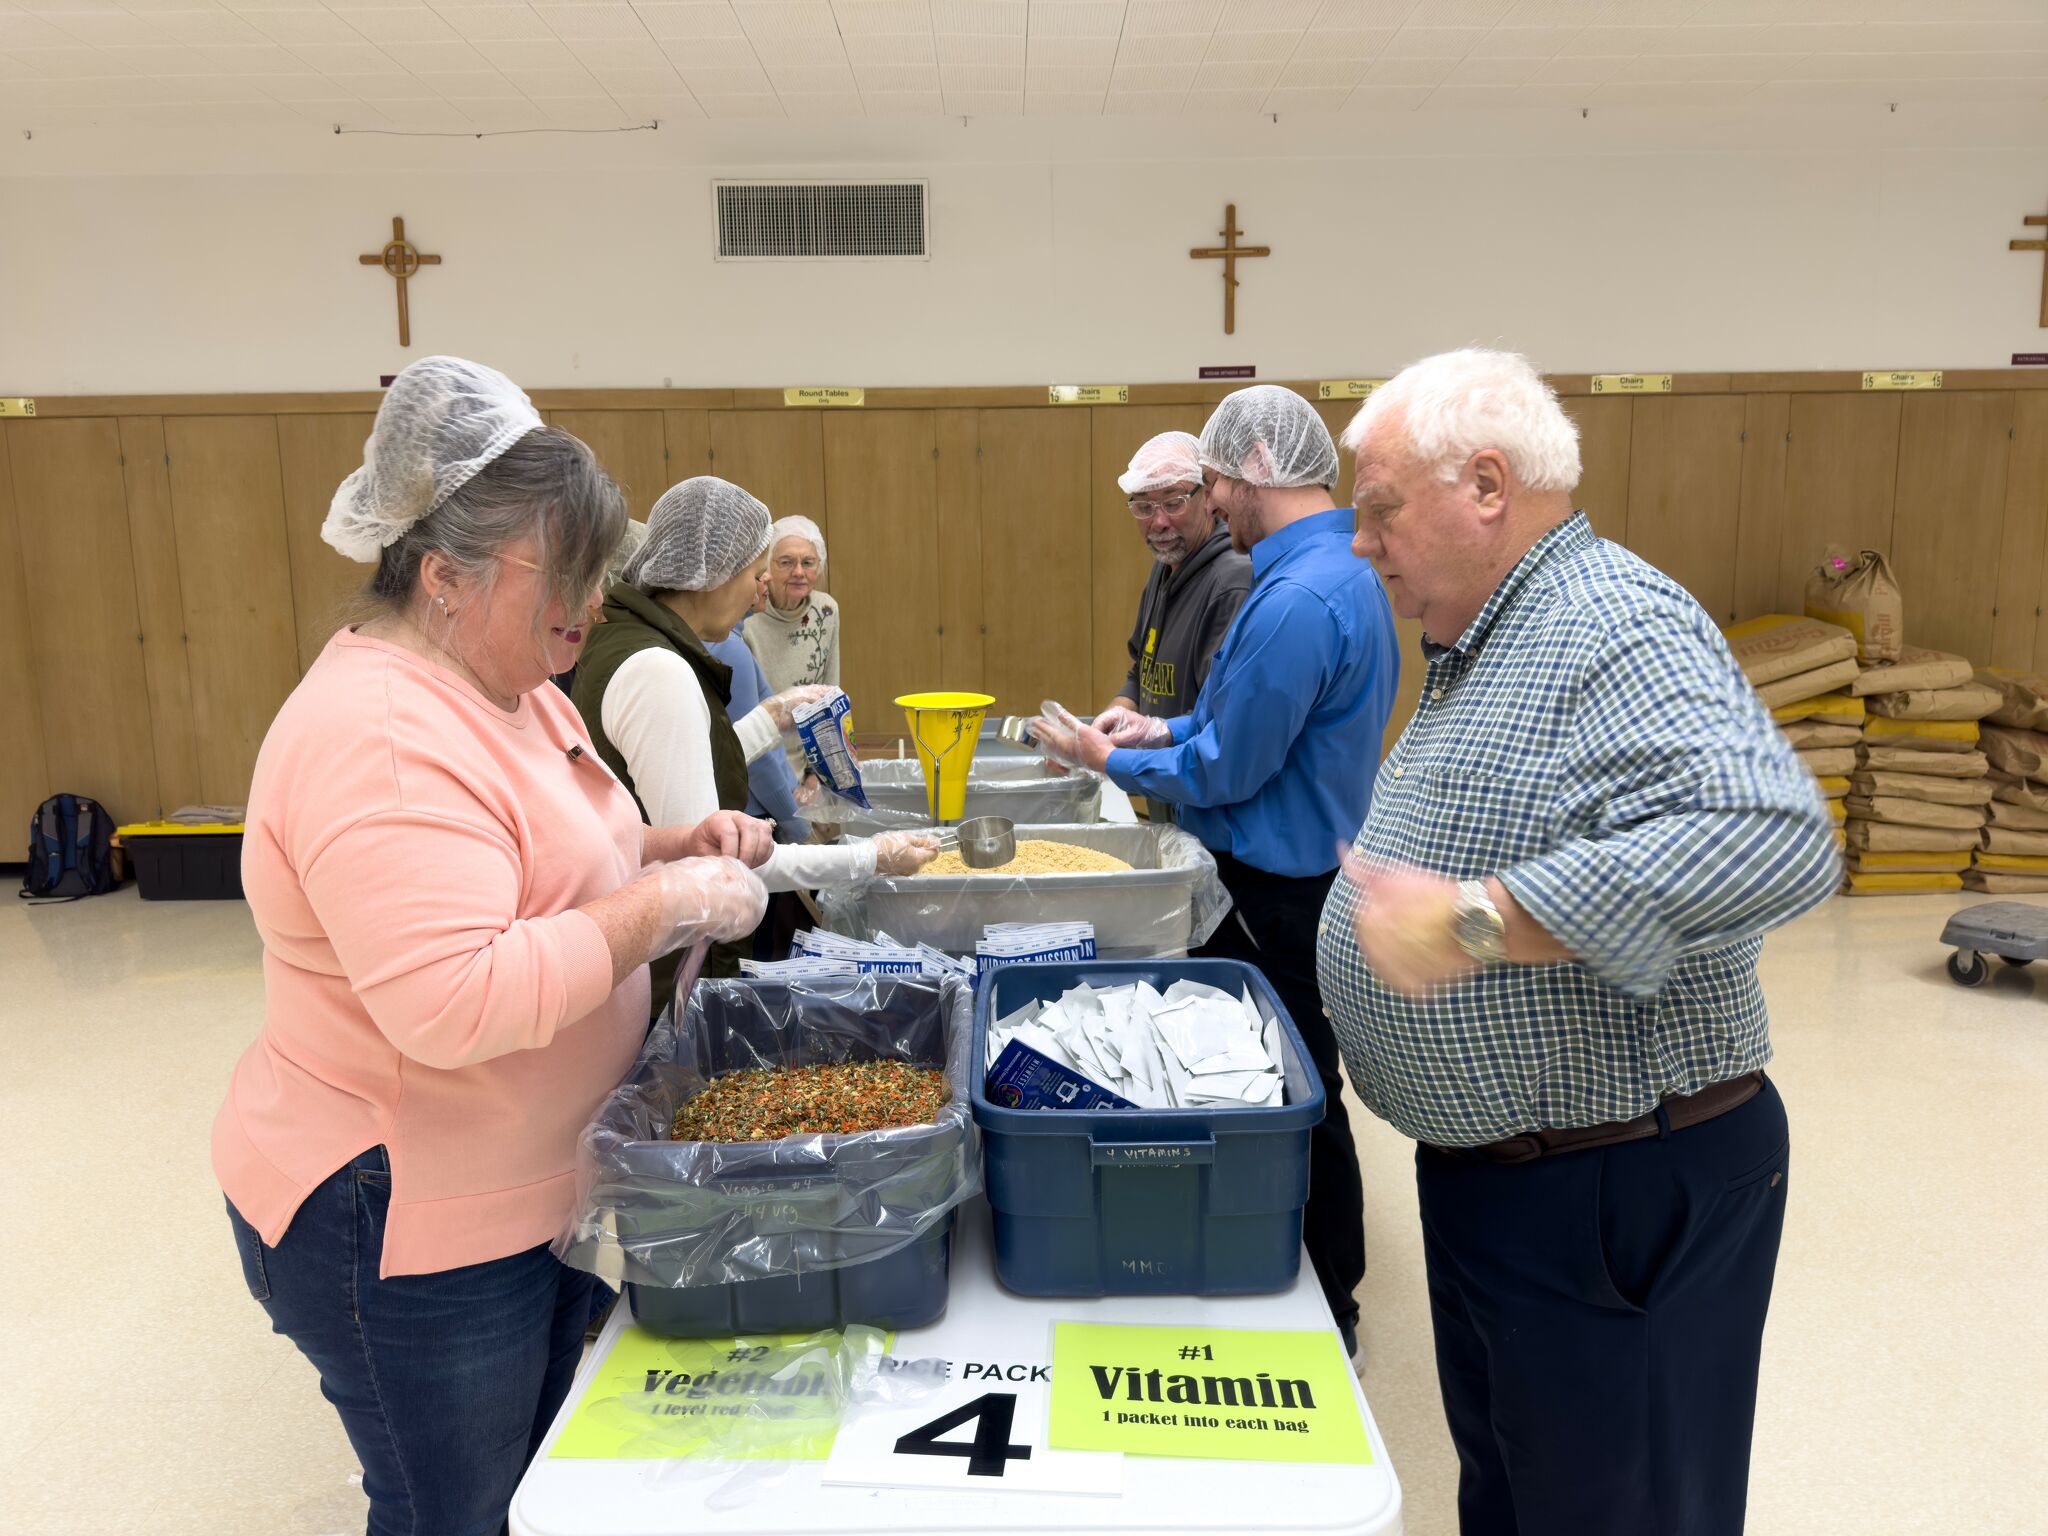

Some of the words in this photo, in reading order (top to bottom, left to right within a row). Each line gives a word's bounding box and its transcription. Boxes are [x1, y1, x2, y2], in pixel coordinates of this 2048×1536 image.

[1620, 376, 1644, 384] Chairs
[1865, 376, 1874, 388] 15
[1890, 373, 1915, 381] Chairs
[1932, 374, 1941, 387] 15
[1348, 381, 1373, 390] Chairs
[1593, 379, 1603, 391] 15
[1662, 378, 1671, 390] 15
[799, 389, 823, 397] Round
[824, 389, 849, 397] Tables
[1077, 387, 1101, 396] Chairs
[1118, 389, 1128, 402] 15
[1321, 385, 1331, 397] 15
[23, 402, 34, 415] 15
[1106, 1148, 1115, 1160] 4
[1124, 1147, 1191, 1159] VITAMINS
[727, 1346, 769, 1362] #2
[1178, 1344, 1214, 1361] #1
[962, 1362, 1053, 1382] PACK
[1089, 1365, 1317, 1409] Vitamin
[664, 1404, 705, 1416] level
[710, 1404, 740, 1416] red
[1102, 1410, 1111, 1421] 1
[1117, 1411, 1178, 1425] packet
[1183, 1414, 1219, 1428] into
[1225, 1417, 1268, 1430] each
[1274, 1419, 1310, 1433] bag
[893, 1392, 1032, 1477] 4
